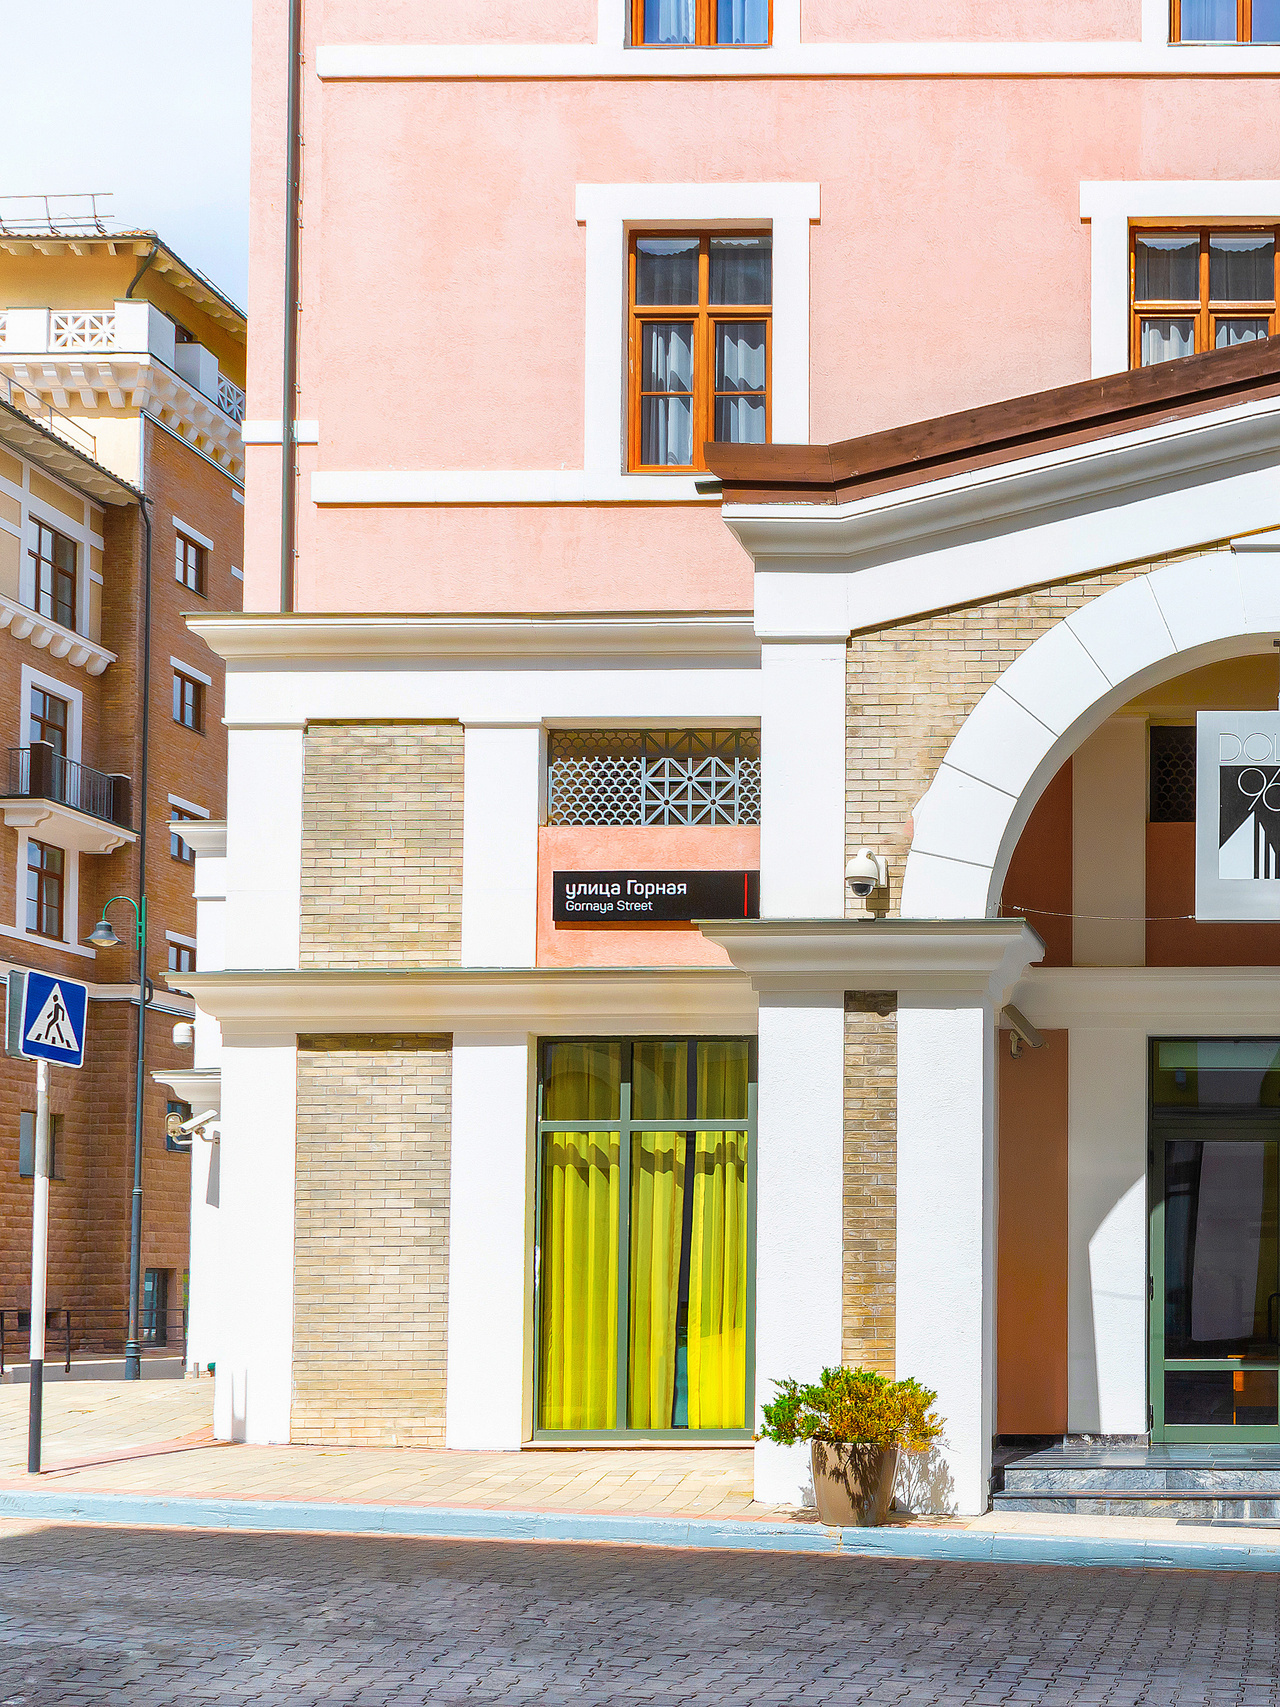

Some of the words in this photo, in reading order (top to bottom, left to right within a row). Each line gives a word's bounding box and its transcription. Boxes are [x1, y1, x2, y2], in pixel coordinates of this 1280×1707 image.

[565, 882, 621, 899] улица
[626, 879, 688, 899] Горная
[565, 900, 614, 914] Gornaya
[616, 900, 654, 911] Street
